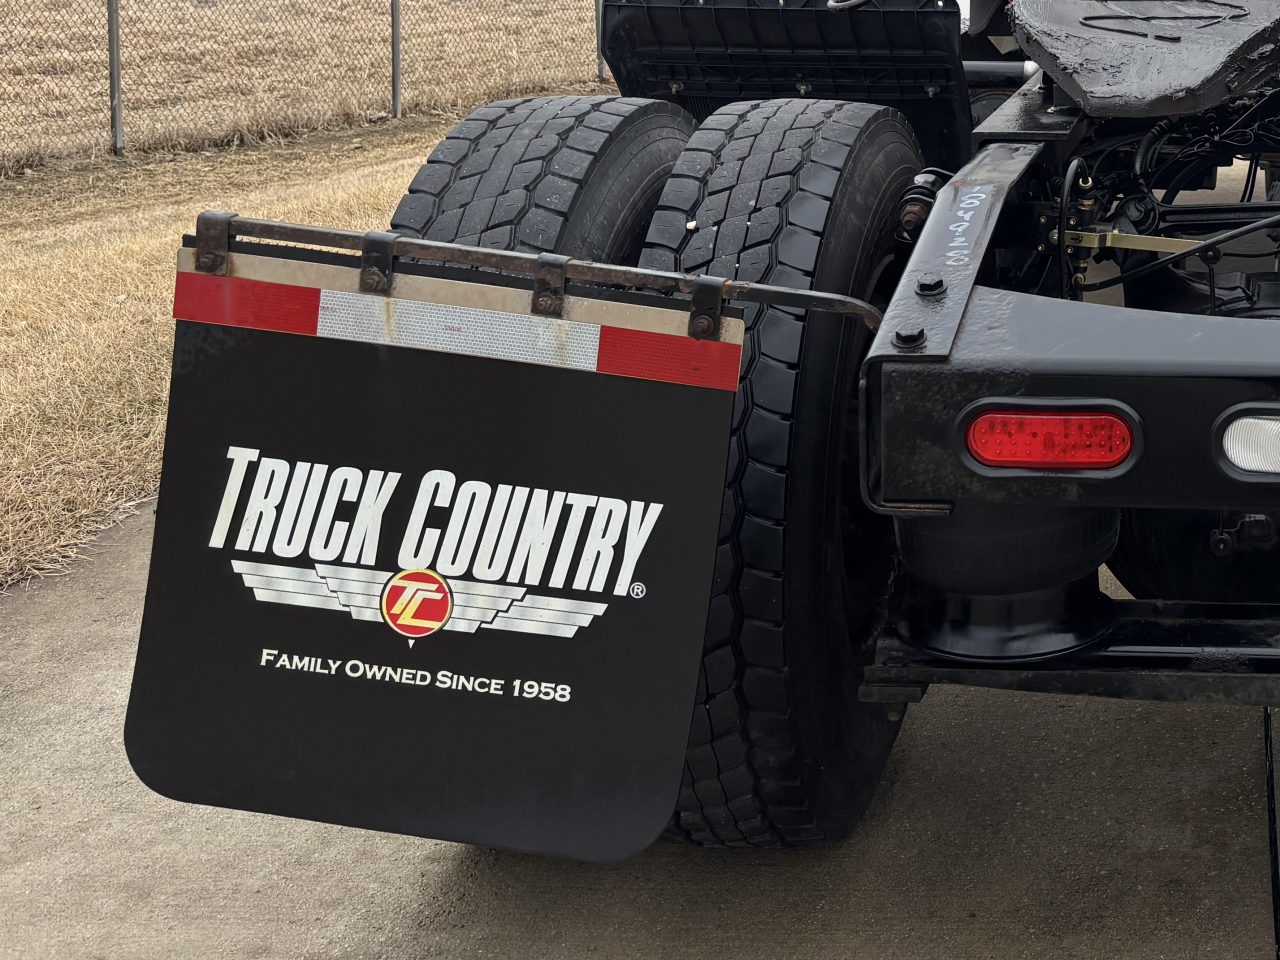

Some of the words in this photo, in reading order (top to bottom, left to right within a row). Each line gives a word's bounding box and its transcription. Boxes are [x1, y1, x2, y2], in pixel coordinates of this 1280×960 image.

[208, 446, 402, 566] TRUCK
[260, 649, 342, 676] FAMILY
[344, 660, 432, 687] OWNED
[435, 671, 505, 696] SINCE
[511, 679, 572, 703] 1958
